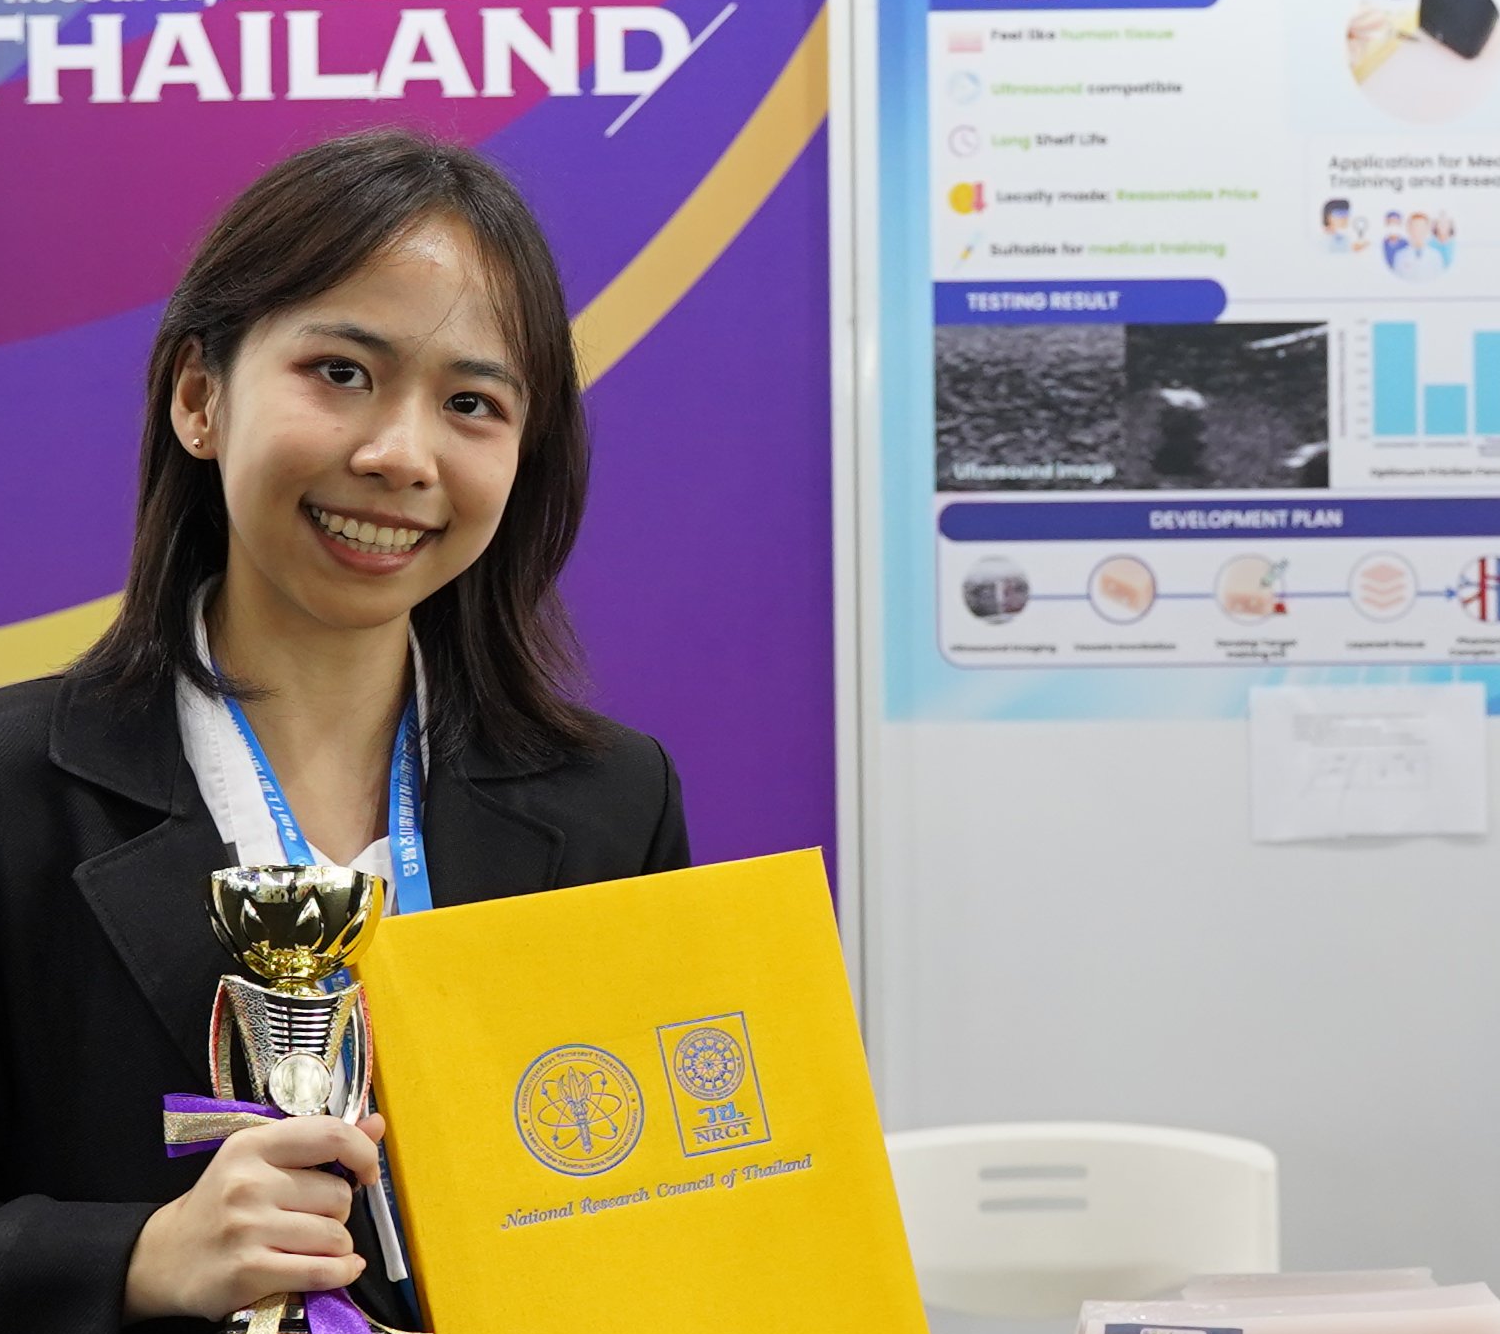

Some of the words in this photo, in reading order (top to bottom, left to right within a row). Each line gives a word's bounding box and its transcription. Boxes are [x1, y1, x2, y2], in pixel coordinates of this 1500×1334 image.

[1328, 155, 1434, 174] Application
[1327, 175, 1405, 191] Training
[1409, 174, 1445, 190] and
[1050, 289, 1121, 311] RESULT
[1149, 510, 1289, 529] DEVELOPMENT
[1290, 509, 1343, 528] PLAN
[694, 1122, 752, 1144] NRCT
[501, 1201, 574, 1230] National
[580, 1187, 650, 1216] Research
[656, 1175, 715, 1199] Council
[721, 1168, 738, 1189] of
[743, 1154, 812, 1182] Thailand
